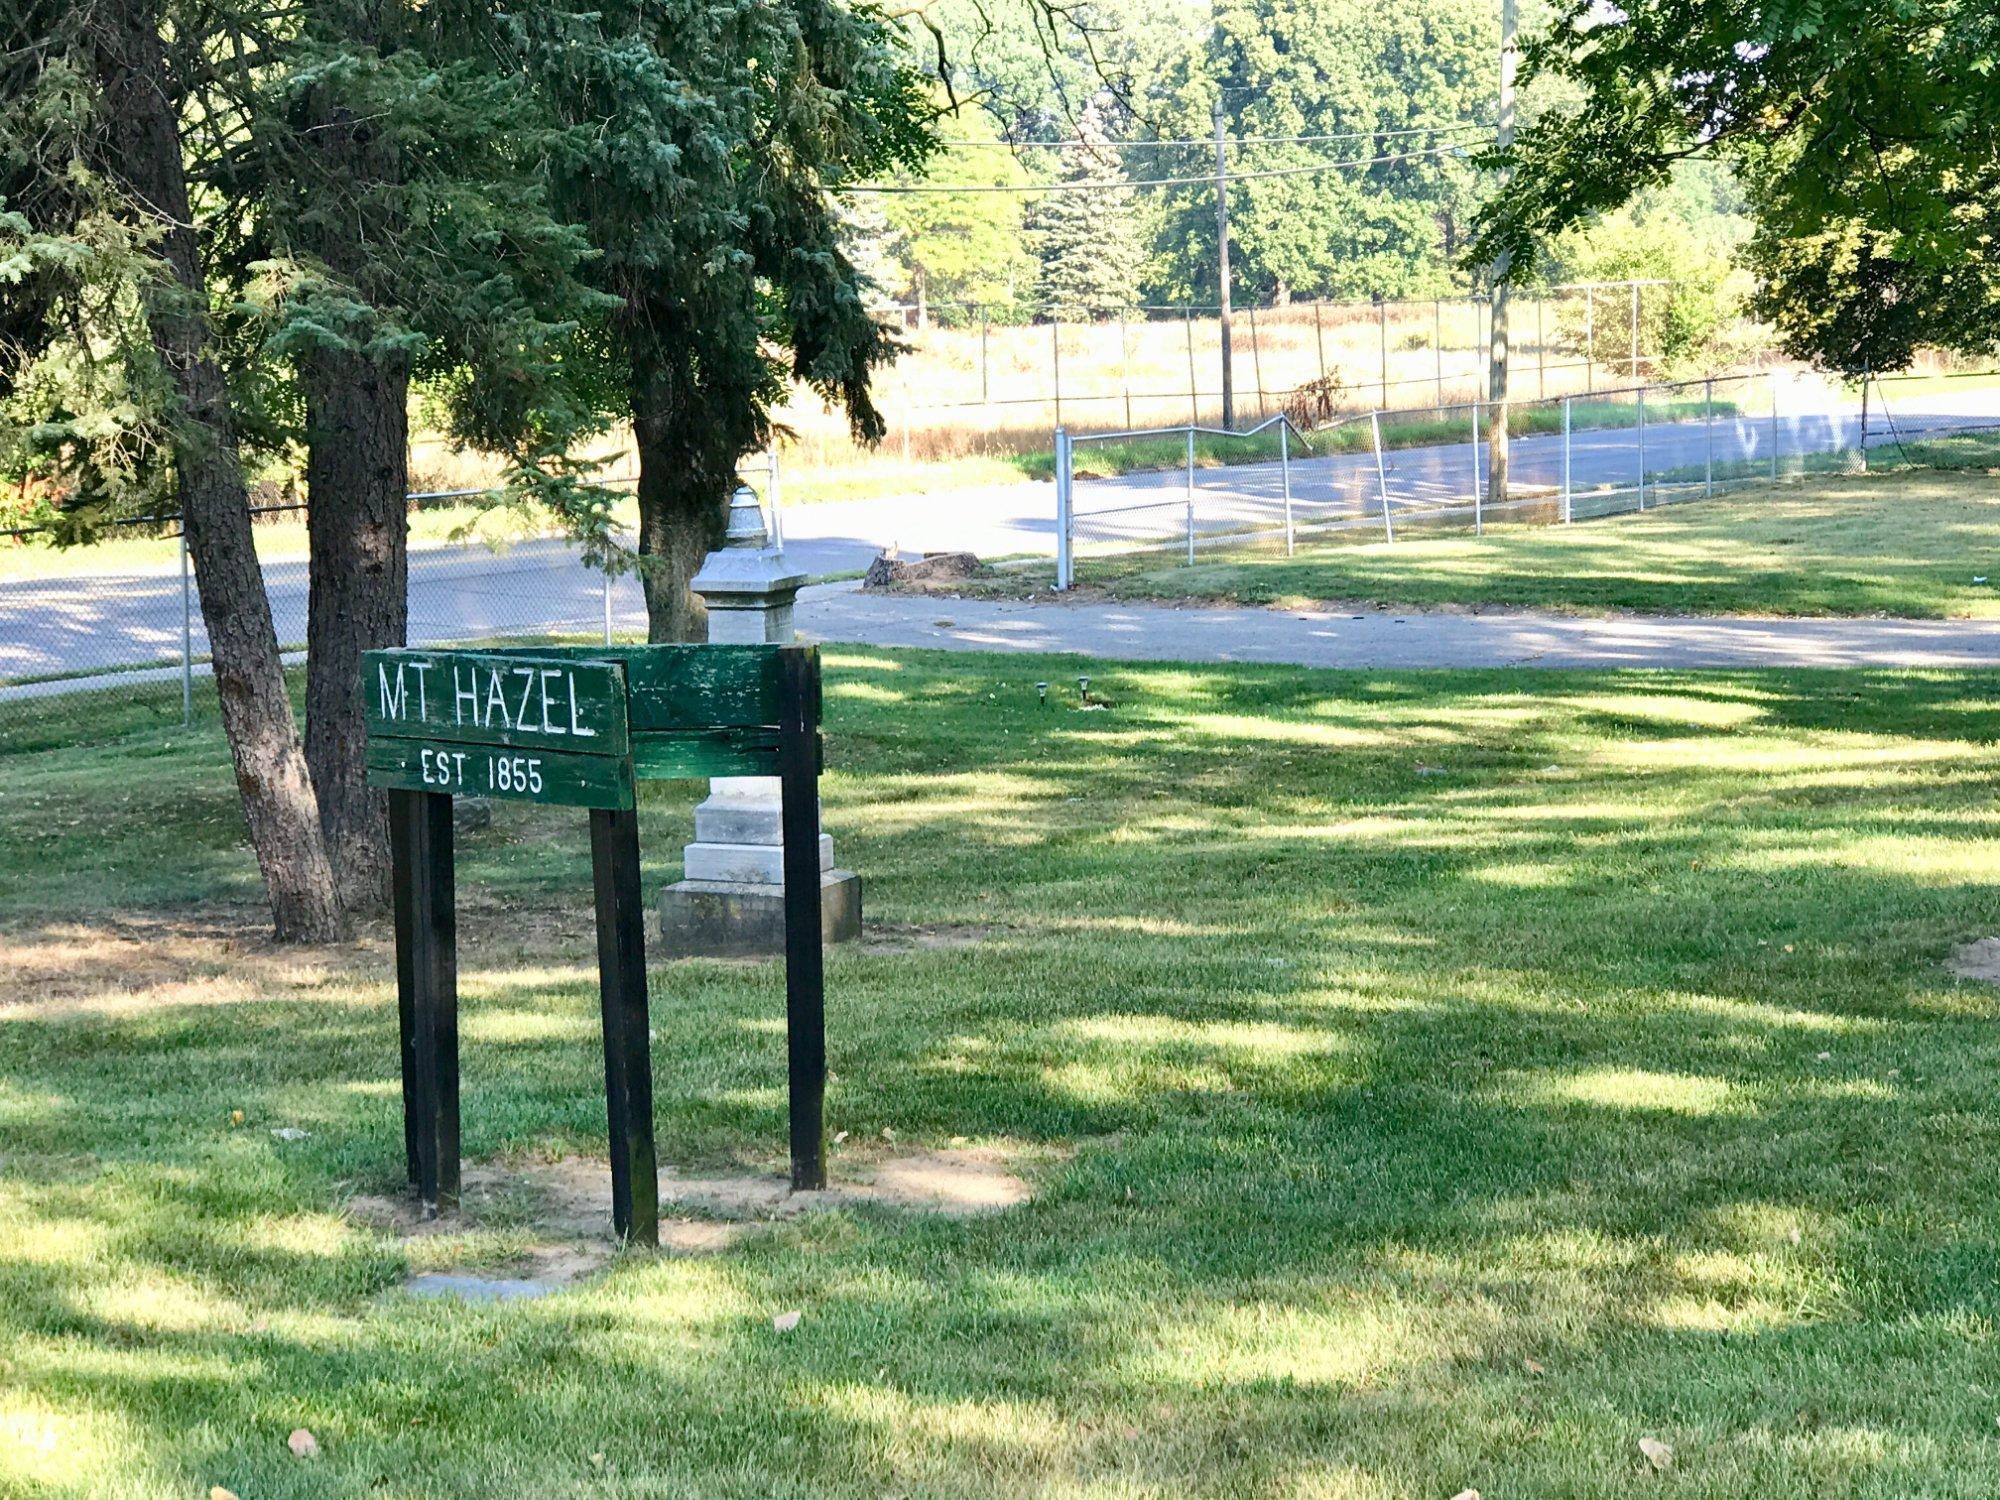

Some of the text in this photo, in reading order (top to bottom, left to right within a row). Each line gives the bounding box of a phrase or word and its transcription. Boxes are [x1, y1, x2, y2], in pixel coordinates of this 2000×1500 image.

[378, 661, 597, 737] MT HAZEL
[420, 748, 543, 794] EST 1855
